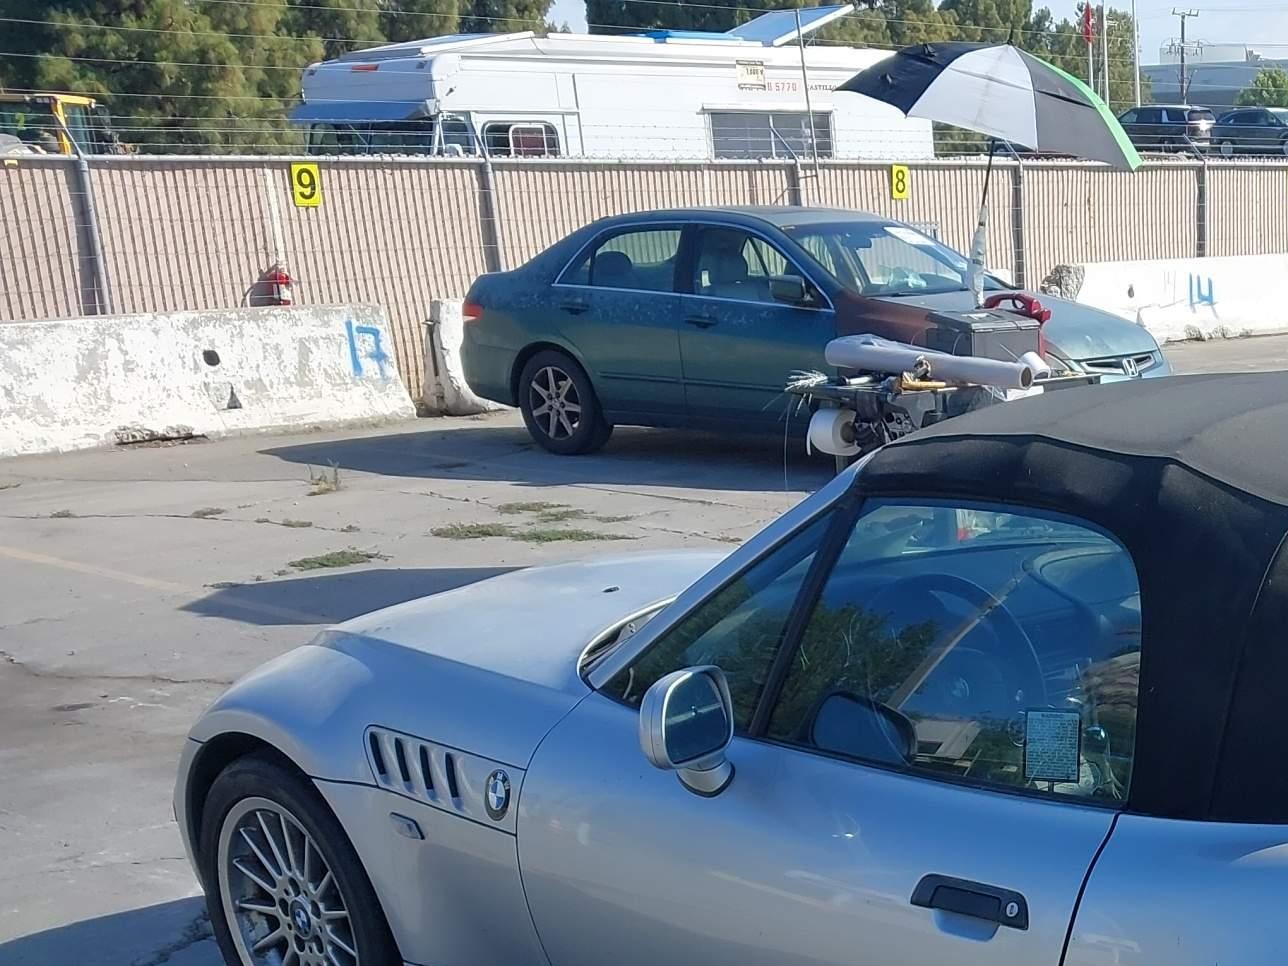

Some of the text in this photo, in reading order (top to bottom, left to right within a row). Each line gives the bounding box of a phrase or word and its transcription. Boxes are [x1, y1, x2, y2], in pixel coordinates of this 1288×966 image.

[296, 167, 317, 200] 9
[895, 169, 906, 194] 8
[1188, 271, 1219, 316] 14
